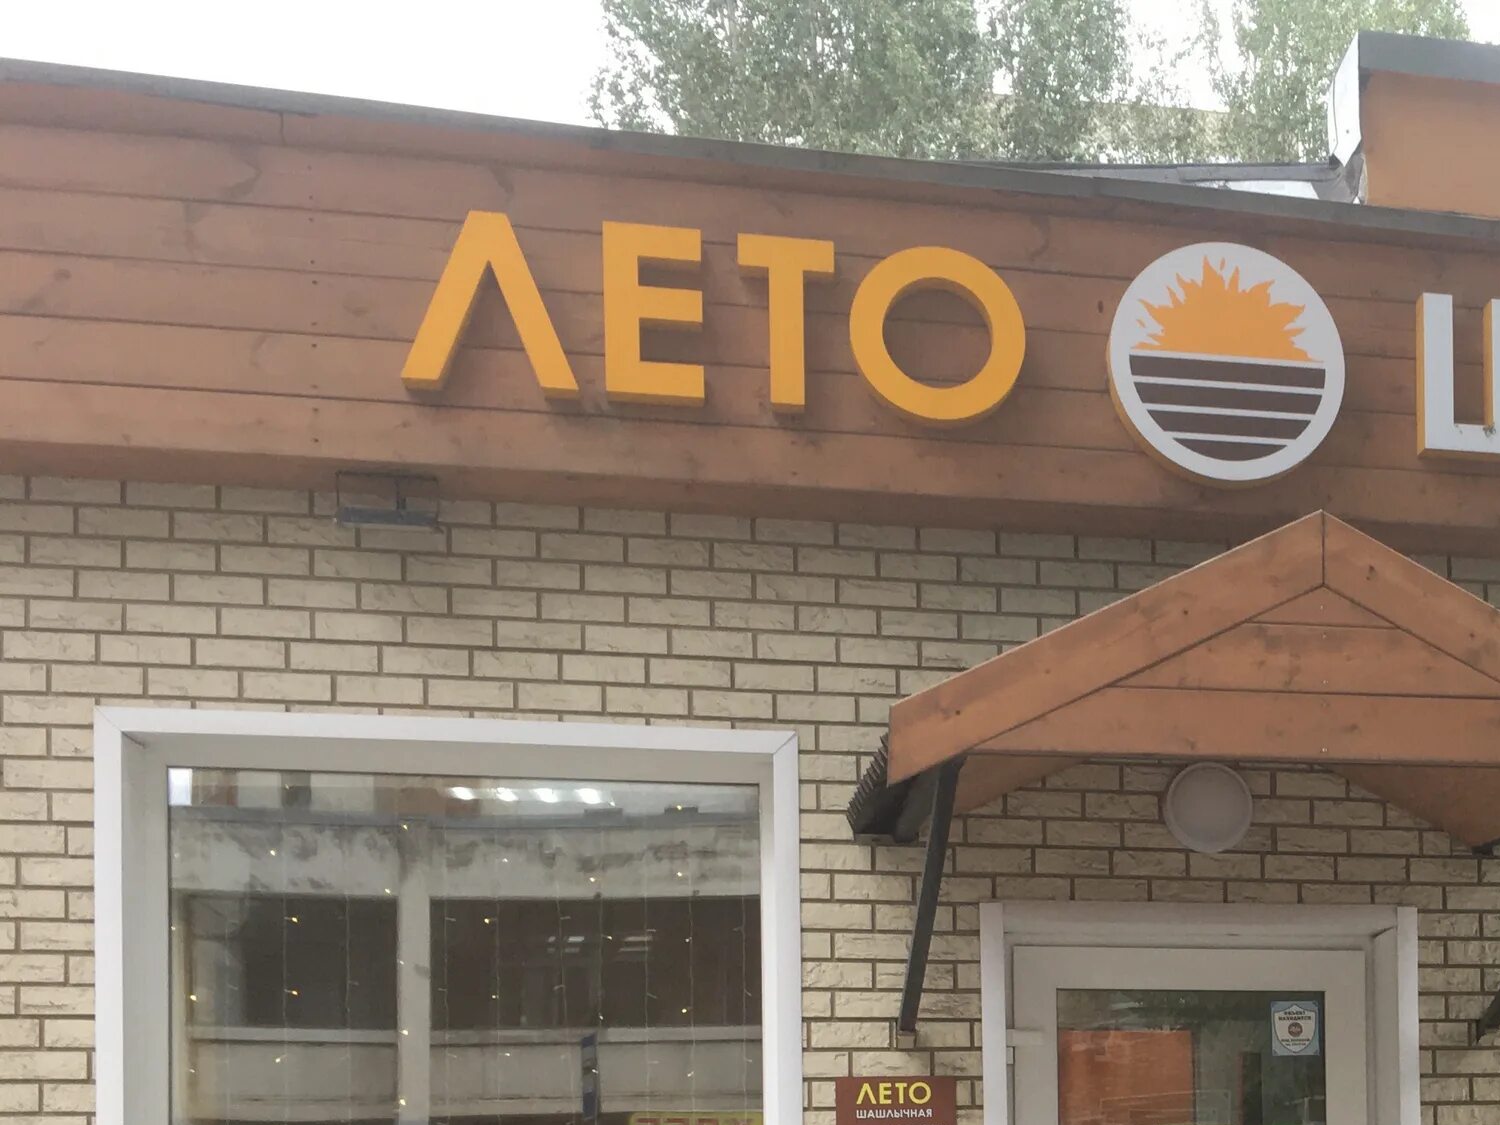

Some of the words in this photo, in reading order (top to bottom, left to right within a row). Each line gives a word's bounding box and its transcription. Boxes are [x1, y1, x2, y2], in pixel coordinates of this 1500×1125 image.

[400, 209, 1027, 422] ЛЕТО
[856, 1081, 932, 1105] ЛЕТО
[855, 1108, 933, 1119] ШАШЛЫЧНАЯ
